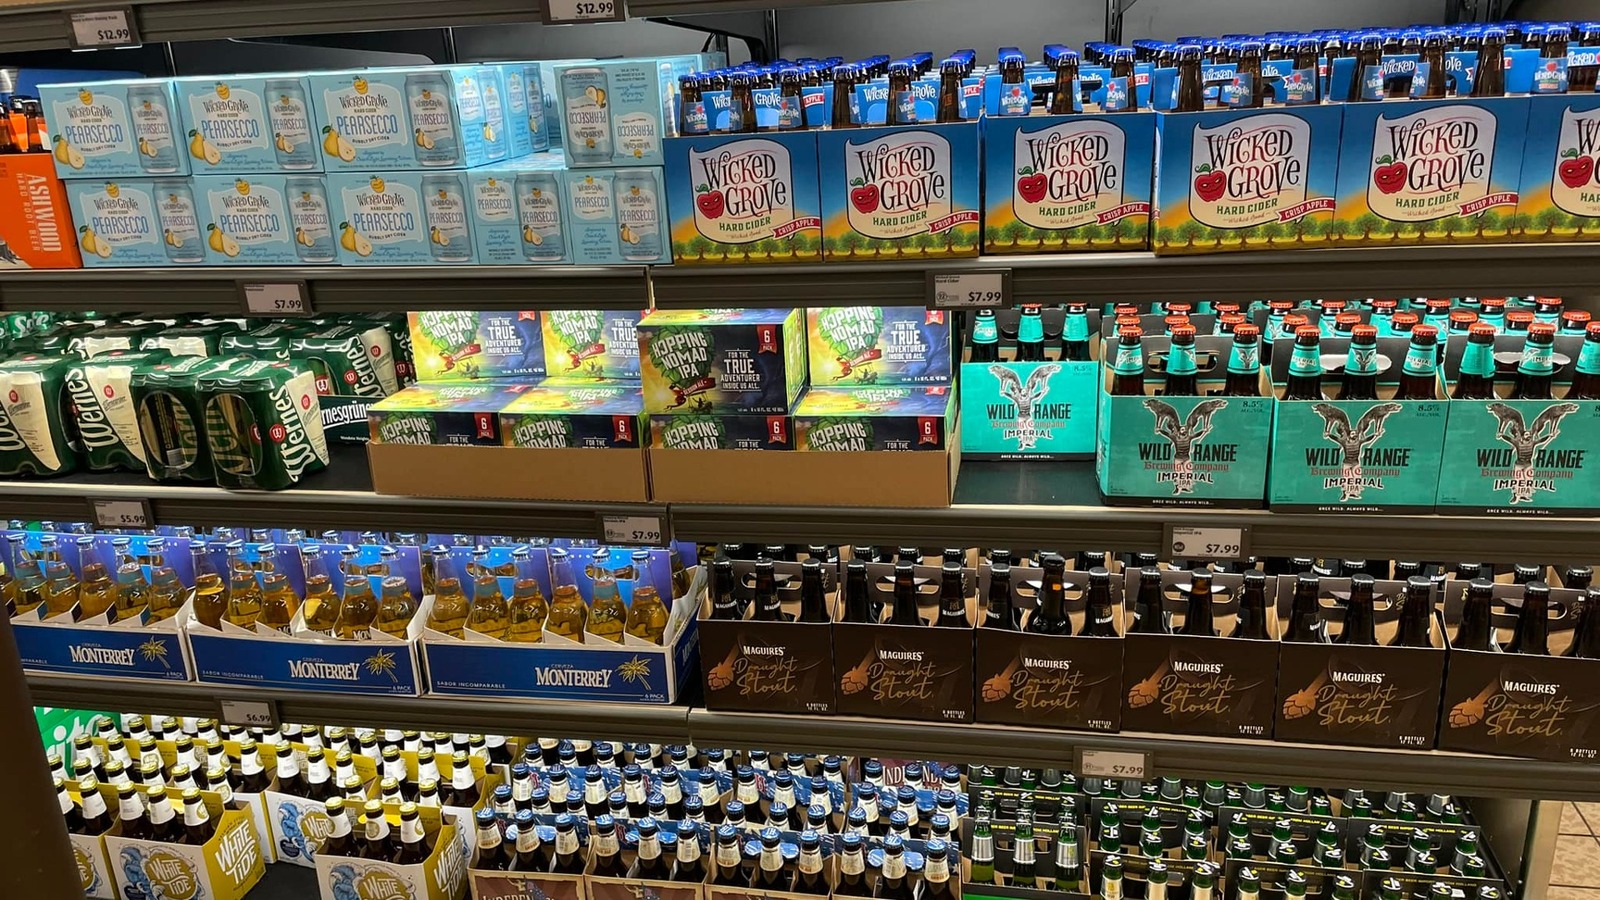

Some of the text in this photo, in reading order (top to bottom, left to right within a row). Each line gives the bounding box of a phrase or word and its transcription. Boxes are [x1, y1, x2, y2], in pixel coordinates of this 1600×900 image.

[576, 2, 612, 14] $12.99
[98, 29, 128, 40] $12.99
[273, 118, 306, 130] PEARSECCO
[337, 114, 398, 135] PEARSECCO
[414, 114, 449, 126] PEARSECCO
[66, 124, 124, 144] PEARSECCO
[202, 119, 259, 139] PEARSECCO
[1396, 192, 1459, 208] HARD CIDER
[1466, 194, 1511, 213] CRISP APPLE
[1581, 192, 1600, 203] HAR
[26, 174, 62, 251] ASHWOOD
[1039, 202, 1096, 216] HARD CIDER
[1102, 204, 1143, 221] CRISP APPLE
[1217, 198, 1278, 215] HARD CIDER
[1285, 200, 1328, 219] CRISP APPLE
[23, 202, 40, 251] ROOT BEER
[93, 216, 149, 234] PEARSECCO
[220, 214, 279, 232] PEARSECCO
[354, 212, 414, 231] PEARSECCO
[719, 216, 771, 231] HARD CIDER
[873, 211, 926, 226] HARD CIDER
[934, 212, 972, 231] CRISP APPLE
[778, 219, 814, 236] CRISP APPLE
[274, 300, 301, 308] $7.99
[968, 291, 1001, 302] $7.99
[561, 317, 597, 336] NOMAD
[821, 306, 875, 331] HOPPING
[430, 317, 472, 339] NOMAD
[488, 326, 516, 339] TRUE
[612, 328, 637, 341] TRUE
[764, 330, 770, 343] 6
[830, 320, 875, 343] NOMAD
[446, 332, 465, 346] IPA
[574, 331, 591, 344] IPA
[652, 332, 708, 358] HOPPING
[846, 335, 866, 351] IPA
[890, 330, 921, 344] TRUE
[661, 348, 708, 370] NOMAD
[724, 360, 754, 374] TRUE
[679, 364, 699, 379] IPA
[721, 374, 760, 382] ADVENTURER
[322, 401, 376, 424] rnesgrüne
[987, 404, 1071, 419] WILD RANGE
[381, 418, 430, 440] HOPPING
[481, 418, 487, 429] 6
[515, 421, 566, 443] HOPPING
[619, 420, 625, 432] 6
[773, 421, 780, 433] 6
[924, 422, 931, 434] 6
[992, 420, 1065, 429] Brewing Company
[665, 422, 719, 446] HOPPING
[810, 423, 866, 447] HOPPING
[1005, 430, 1052, 438] IMPERIAL
[1138, 443, 1237, 462] WILD RANGE
[1306, 448, 1411, 466] WILD RANGE
[1477, 449, 1585, 468] WILD RANGE
[1144, 461, 1229, 472] Brewing Company
[1311, 467, 1400, 477] Brewing Company
[1481, 468, 1573, 479] Brewing Company
[1157, 473, 1213, 483] IMPERIAL
[1324, 478, 1383, 488] IMPERIAL
[1494, 480, 1556, 491] IMPERIAL
[120, 514, 144, 523] $5.99
[632, 530, 660, 540] $7.99
[1206, 544, 1239, 553] $7.99
[70, 646, 135, 666] MONTERREY
[743, 646, 786, 656] MAGUIRES
[880, 650, 924, 662] MAGUIRES
[288, 660, 360, 680] MONTERREY
[734, 656, 797, 679] Draught
[870, 661, 935, 684] Draught
[1024, 658, 1072, 670] MAGUIRES
[1174, 661, 1224, 674] MAGUIRES
[535, 667, 612, 688] MONTERREY
[737, 673, 795, 695] Stout
[1013, 670, 1084, 693] Draught
[1162, 675, 1235, 697] Draught
[1332, 671, 1385, 684] MAGUIRES
[871, 678, 931, 700] Stout
[1318, 685, 1398, 708] Draught
[1504, 681, 1560, 695] MAGUIRES
[1013, 687, 1078, 710] Stout
[1161, 690, 1228, 714] Stout
[1487, 694, 1571, 719] Draught
[246, 714, 270, 722] $6.99
[1318, 702, 1390, 727] Stout
[1486, 711, 1560, 736] Stout
[1112, 764, 1143, 774] $7.99
[214, 820, 254, 872] WHITE
[150, 858, 183, 880] WHITE
[226, 849, 257, 884] TIDE
[170, 879, 192, 896] TIDE
[365, 876, 398, 898] WHITE
